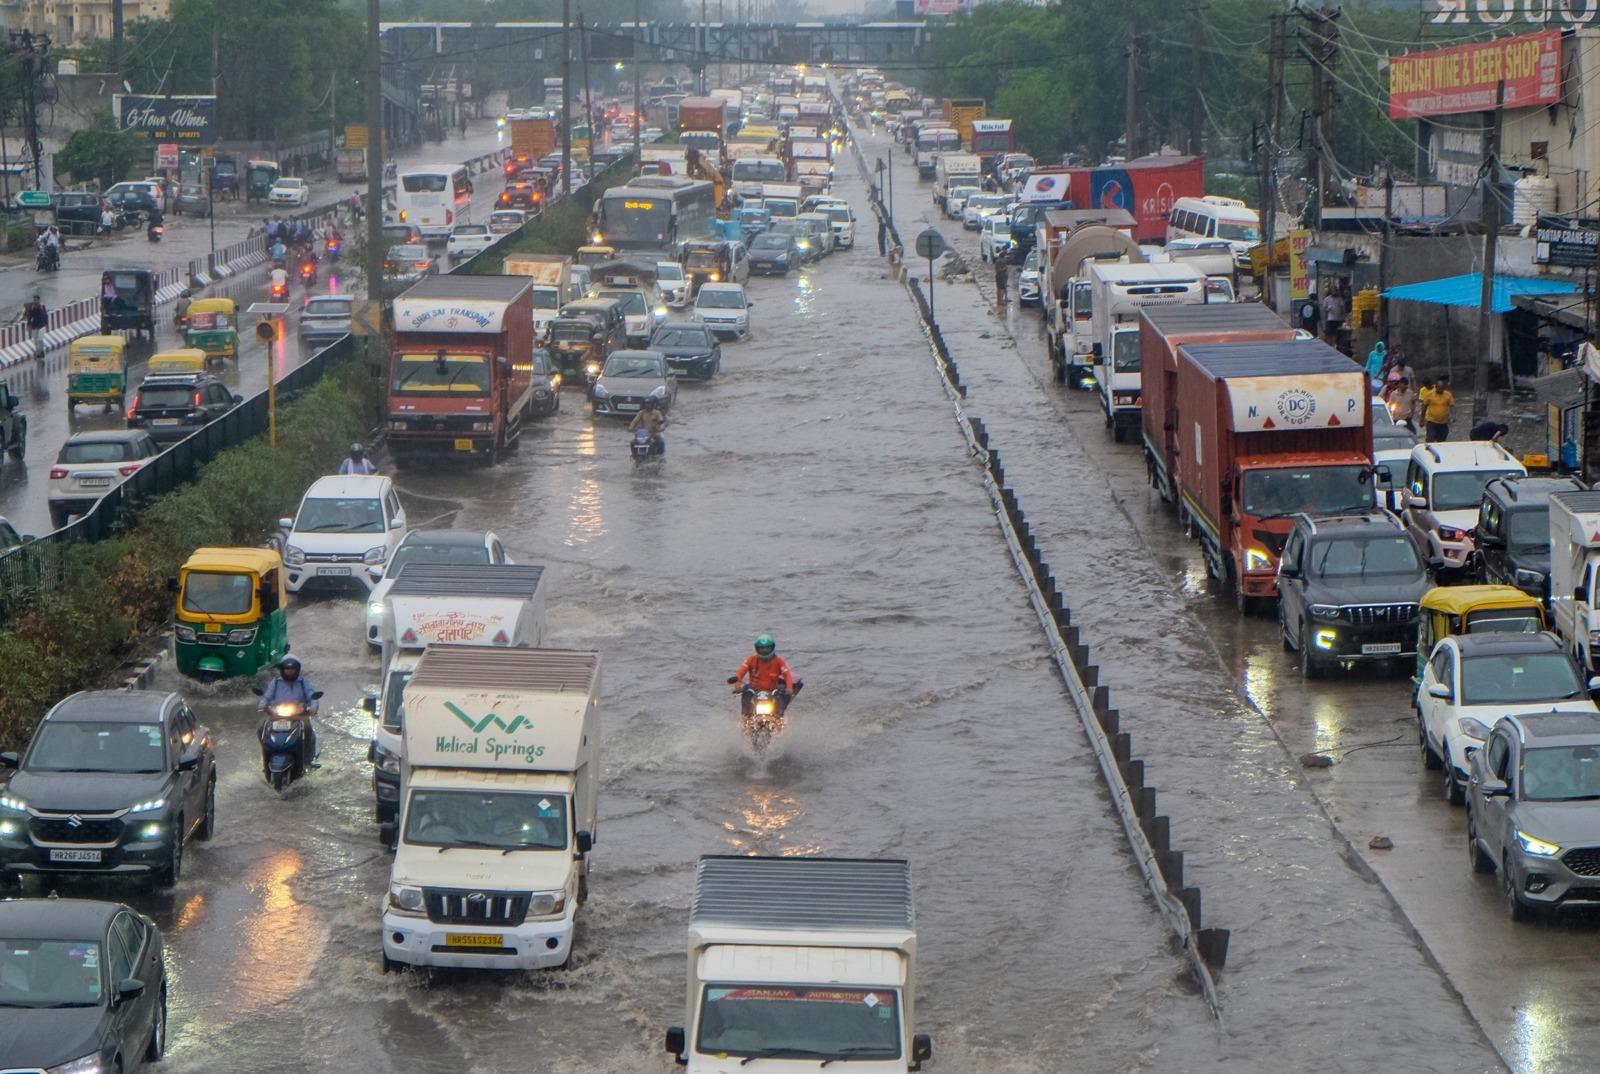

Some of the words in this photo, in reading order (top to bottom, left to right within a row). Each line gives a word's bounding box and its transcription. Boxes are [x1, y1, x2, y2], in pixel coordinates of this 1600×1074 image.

[1390, 57, 1431, 95] ENGLISH
[1434, 52, 1459, 89] WINE
[1462, 51, 1470, 86] &
[1474, 47, 1502, 85] BEER
[1505, 39, 1540, 81] SHOP
[169, 108, 208, 127] Wines
[1537, 228, 1561, 242] PARTAP
[1562, 230, 1583, 244] CRANE
[412, 311, 431, 328] SHRI
[431, 308, 445, 317] SAI
[450, 308, 491, 328] TRANSPORT
[1279, 388, 1313, 399] DYNAMIC
[1289, 399, 1305, 411] DC
[435, 736, 478, 753] Helical
[485, 737, 545, 764] Springs
[746, 989, 790, 997] SANJAY
[809, 991, 861, 1000] AUTOMOTIVE
